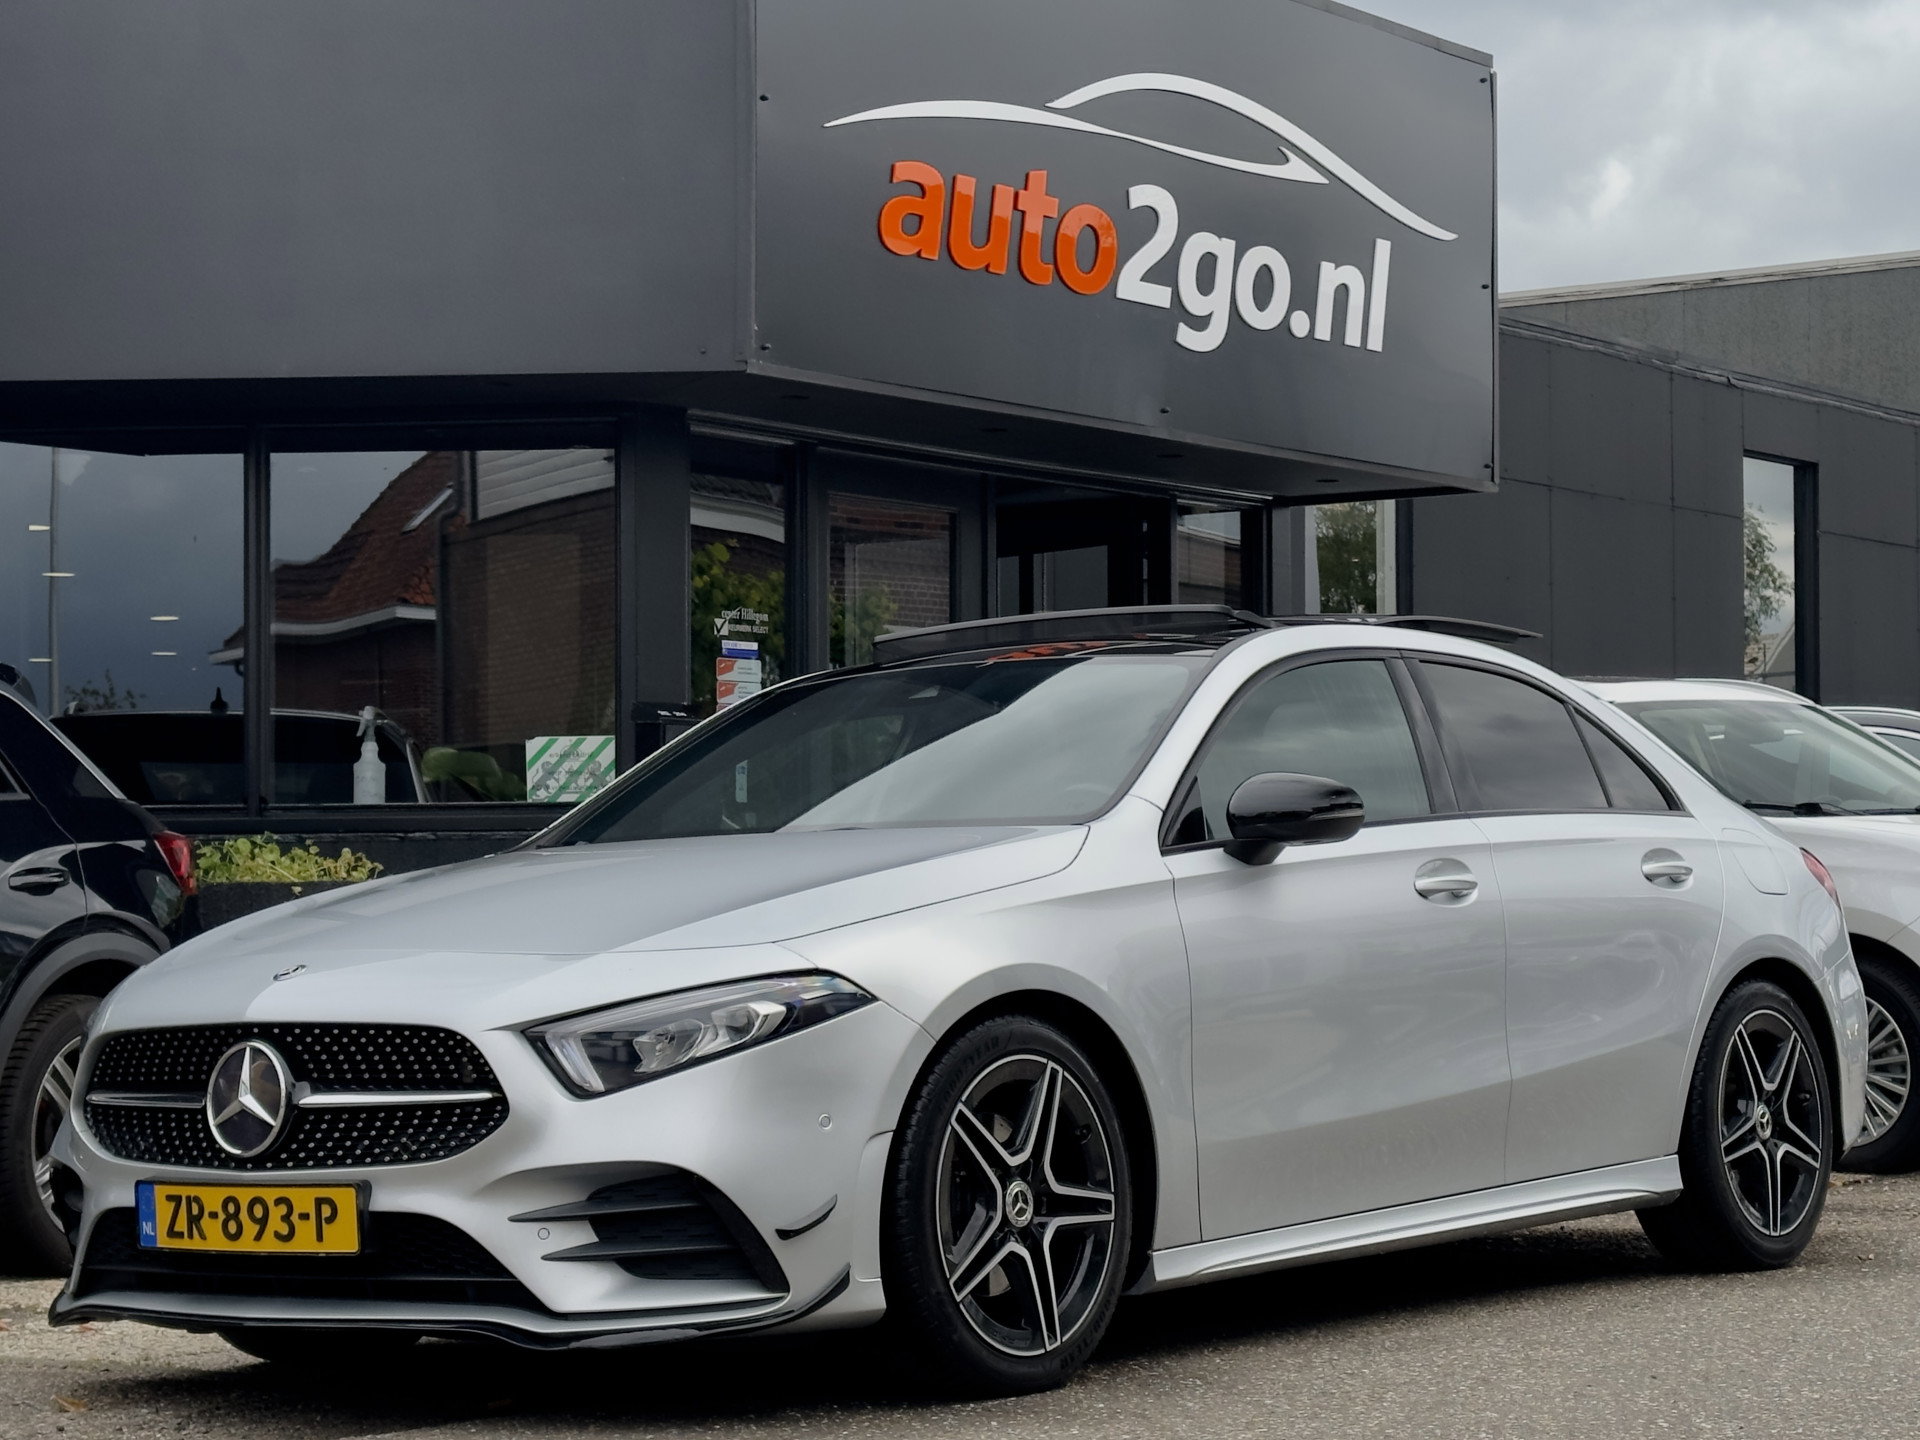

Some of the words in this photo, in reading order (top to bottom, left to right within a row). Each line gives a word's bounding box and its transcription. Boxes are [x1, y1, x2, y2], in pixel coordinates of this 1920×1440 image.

[878, 160, 1392, 353] auto2go.nl
[142, 1221, 155, 1236] NL
[165, 1195, 338, 1242] ZR-893-P
